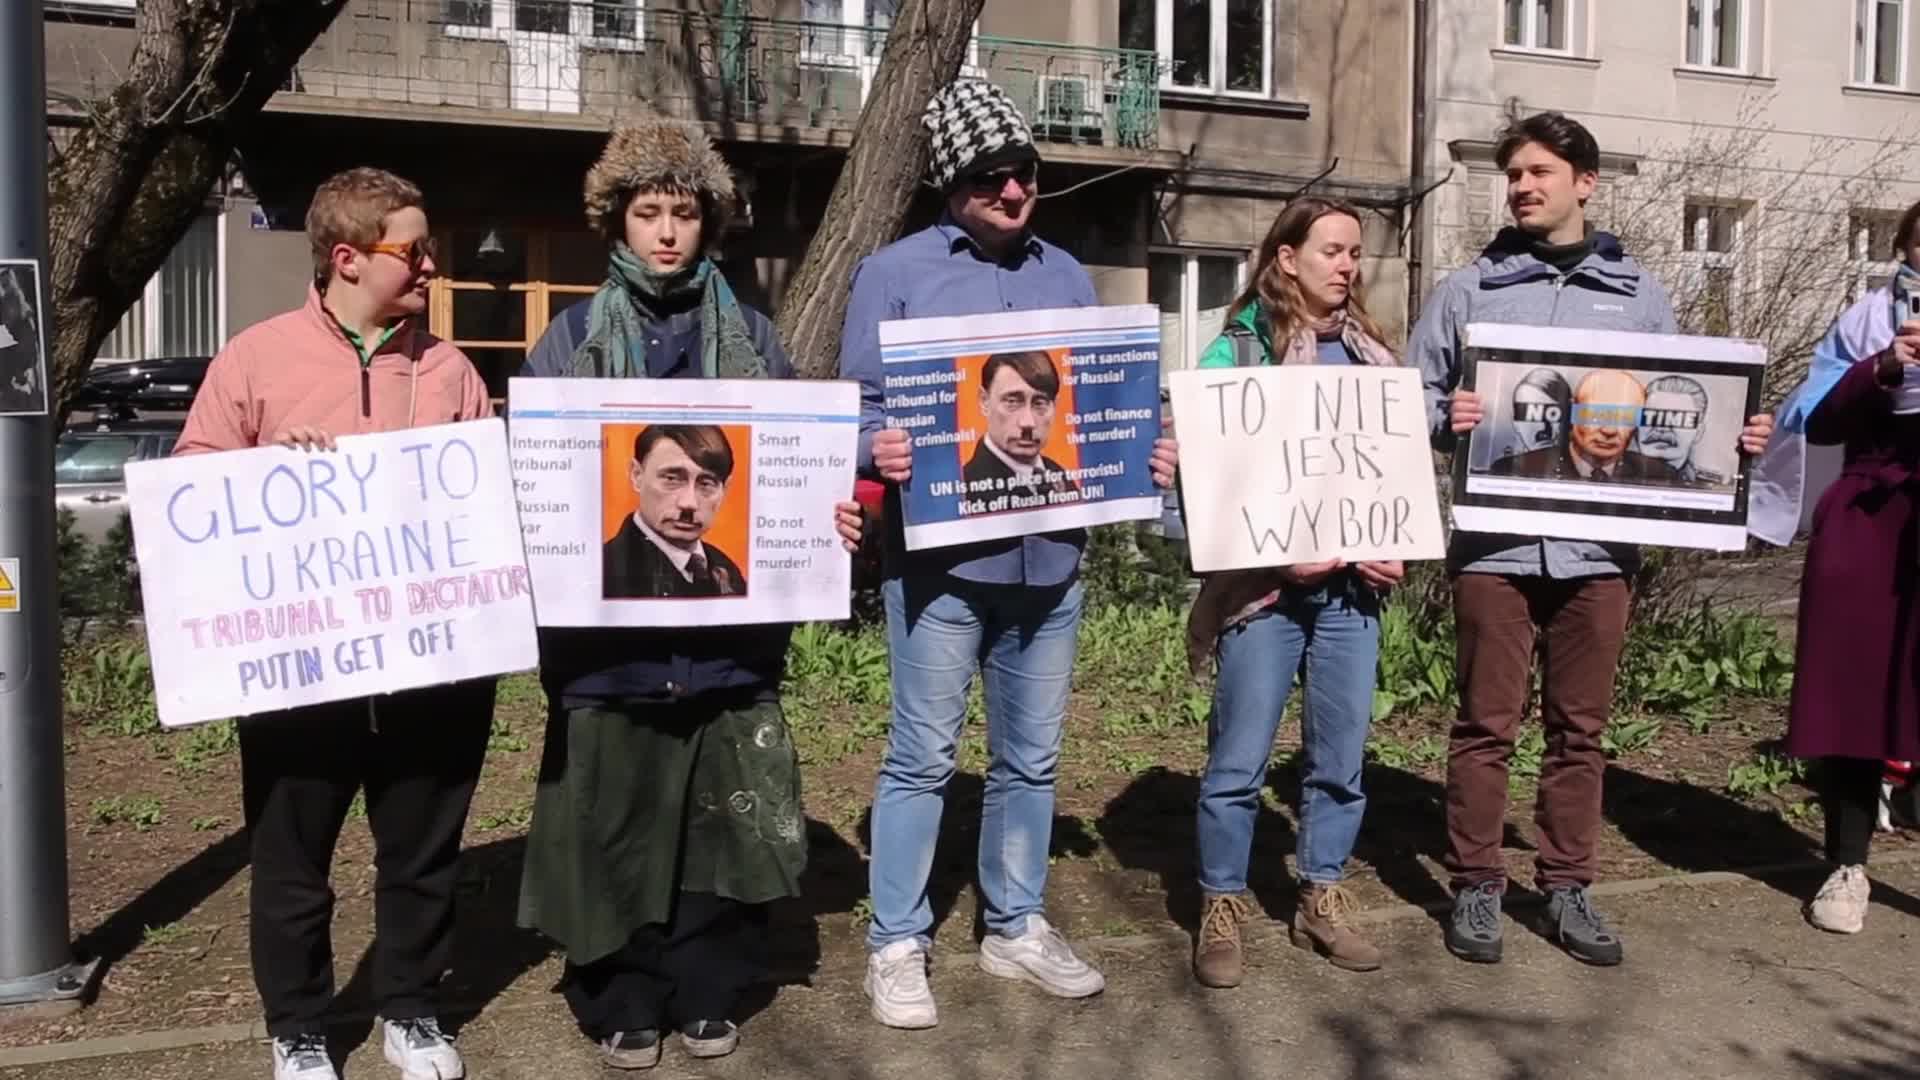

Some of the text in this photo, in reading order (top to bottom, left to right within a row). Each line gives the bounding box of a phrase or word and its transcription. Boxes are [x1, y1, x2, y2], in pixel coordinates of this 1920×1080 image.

[1061, 350, 1158, 366] Smart sanctions
[885, 368, 966, 389] International
[1080, 369, 1125, 384] Russia!
[886, 390, 957, 409] tribunal for
[1205, 376, 1411, 437] TO NIE
[886, 413, 936, 428] Russian
[1065, 408, 1153, 425] Do not finance
[1525, 404, 1562, 422] NO
[1643, 410, 1698, 429] TIME
[513, 436, 608, 449] International
[758, 433, 801, 448] Smart
[915, 429, 976, 447] criminals!
[1066, 426, 1136, 445] the murder!
[513, 458, 572, 471] tribunal
[758, 454, 847, 468] sanctions for
[757, 474, 808, 489] Russia!
[930, 461, 1124, 496] UN is not a place for terrorists!
[167, 438, 479, 544] GLORY TO
[957, 484, 1105, 515] Kick off Rusia from UN!
[756, 516, 804, 529] Do not
[1242, 484, 1415, 555] WYBÓR
[756, 535, 833, 550] finance the
[756, 556, 813, 569] murder!
[182, 565, 531, 649] TRIBUNAL TO DICTATOR
[238, 619, 456, 696] PUTIN GET OFF
